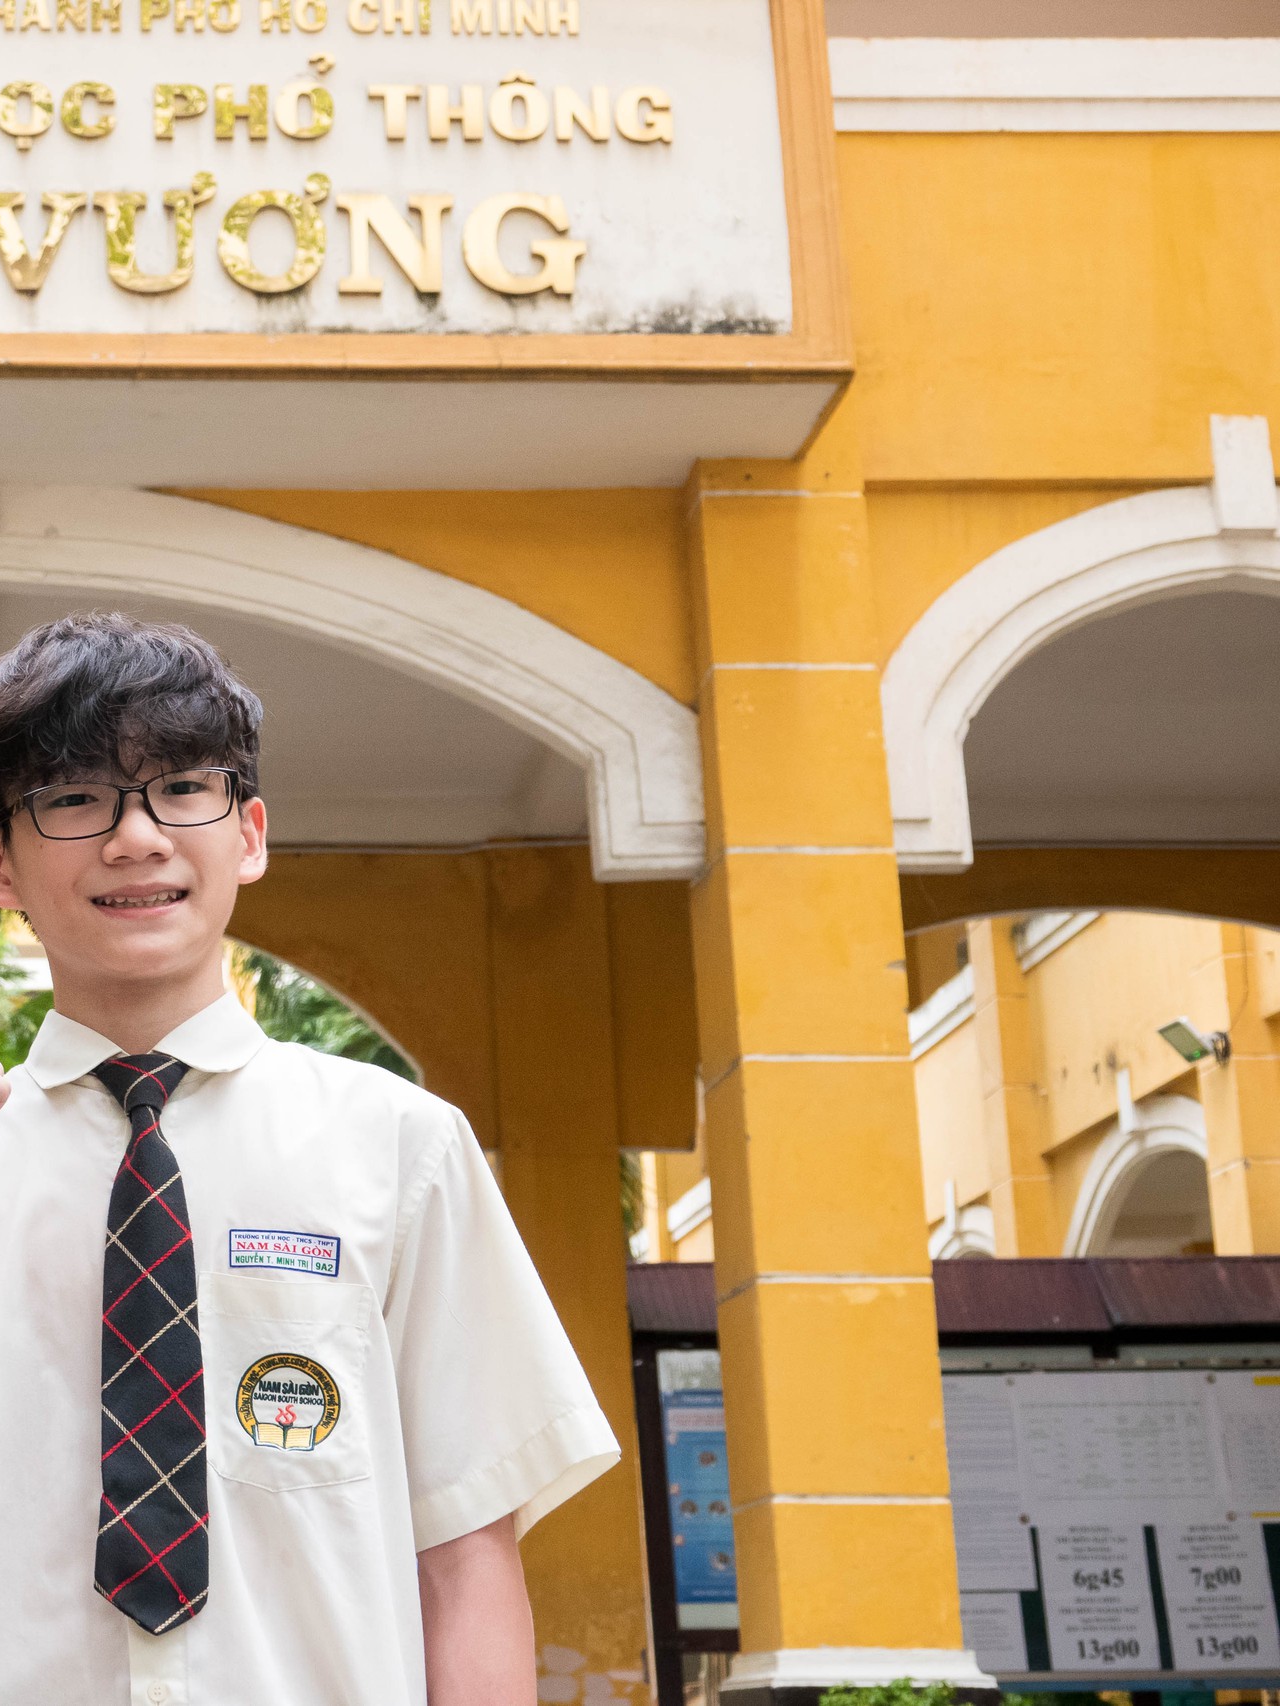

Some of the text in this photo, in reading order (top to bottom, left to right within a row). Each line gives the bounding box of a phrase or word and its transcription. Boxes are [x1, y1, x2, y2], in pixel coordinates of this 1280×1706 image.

[451, 0, 579, 36] MINH
[153, 52, 336, 141] PHỔ
[368, 72, 674, 144] THÔNG
[236, 1241, 332, 1258] NAM SÀI GÒN
[276, 1257, 294, 1266] MINH
[316, 1262, 334, 1272] 9A2
[254, 1392, 324, 1406] SAIGON SOUTH SCHOOL
[258, 1380, 320, 1396] NAM SÀI GÒN
[1073, 1567, 1124, 1591] 6g45
[1190, 1566, 1241, 1590] 7g00
[1077, 1639, 1139, 1663] 13g00
[1196, 1635, 1258, 1660] 13g00
